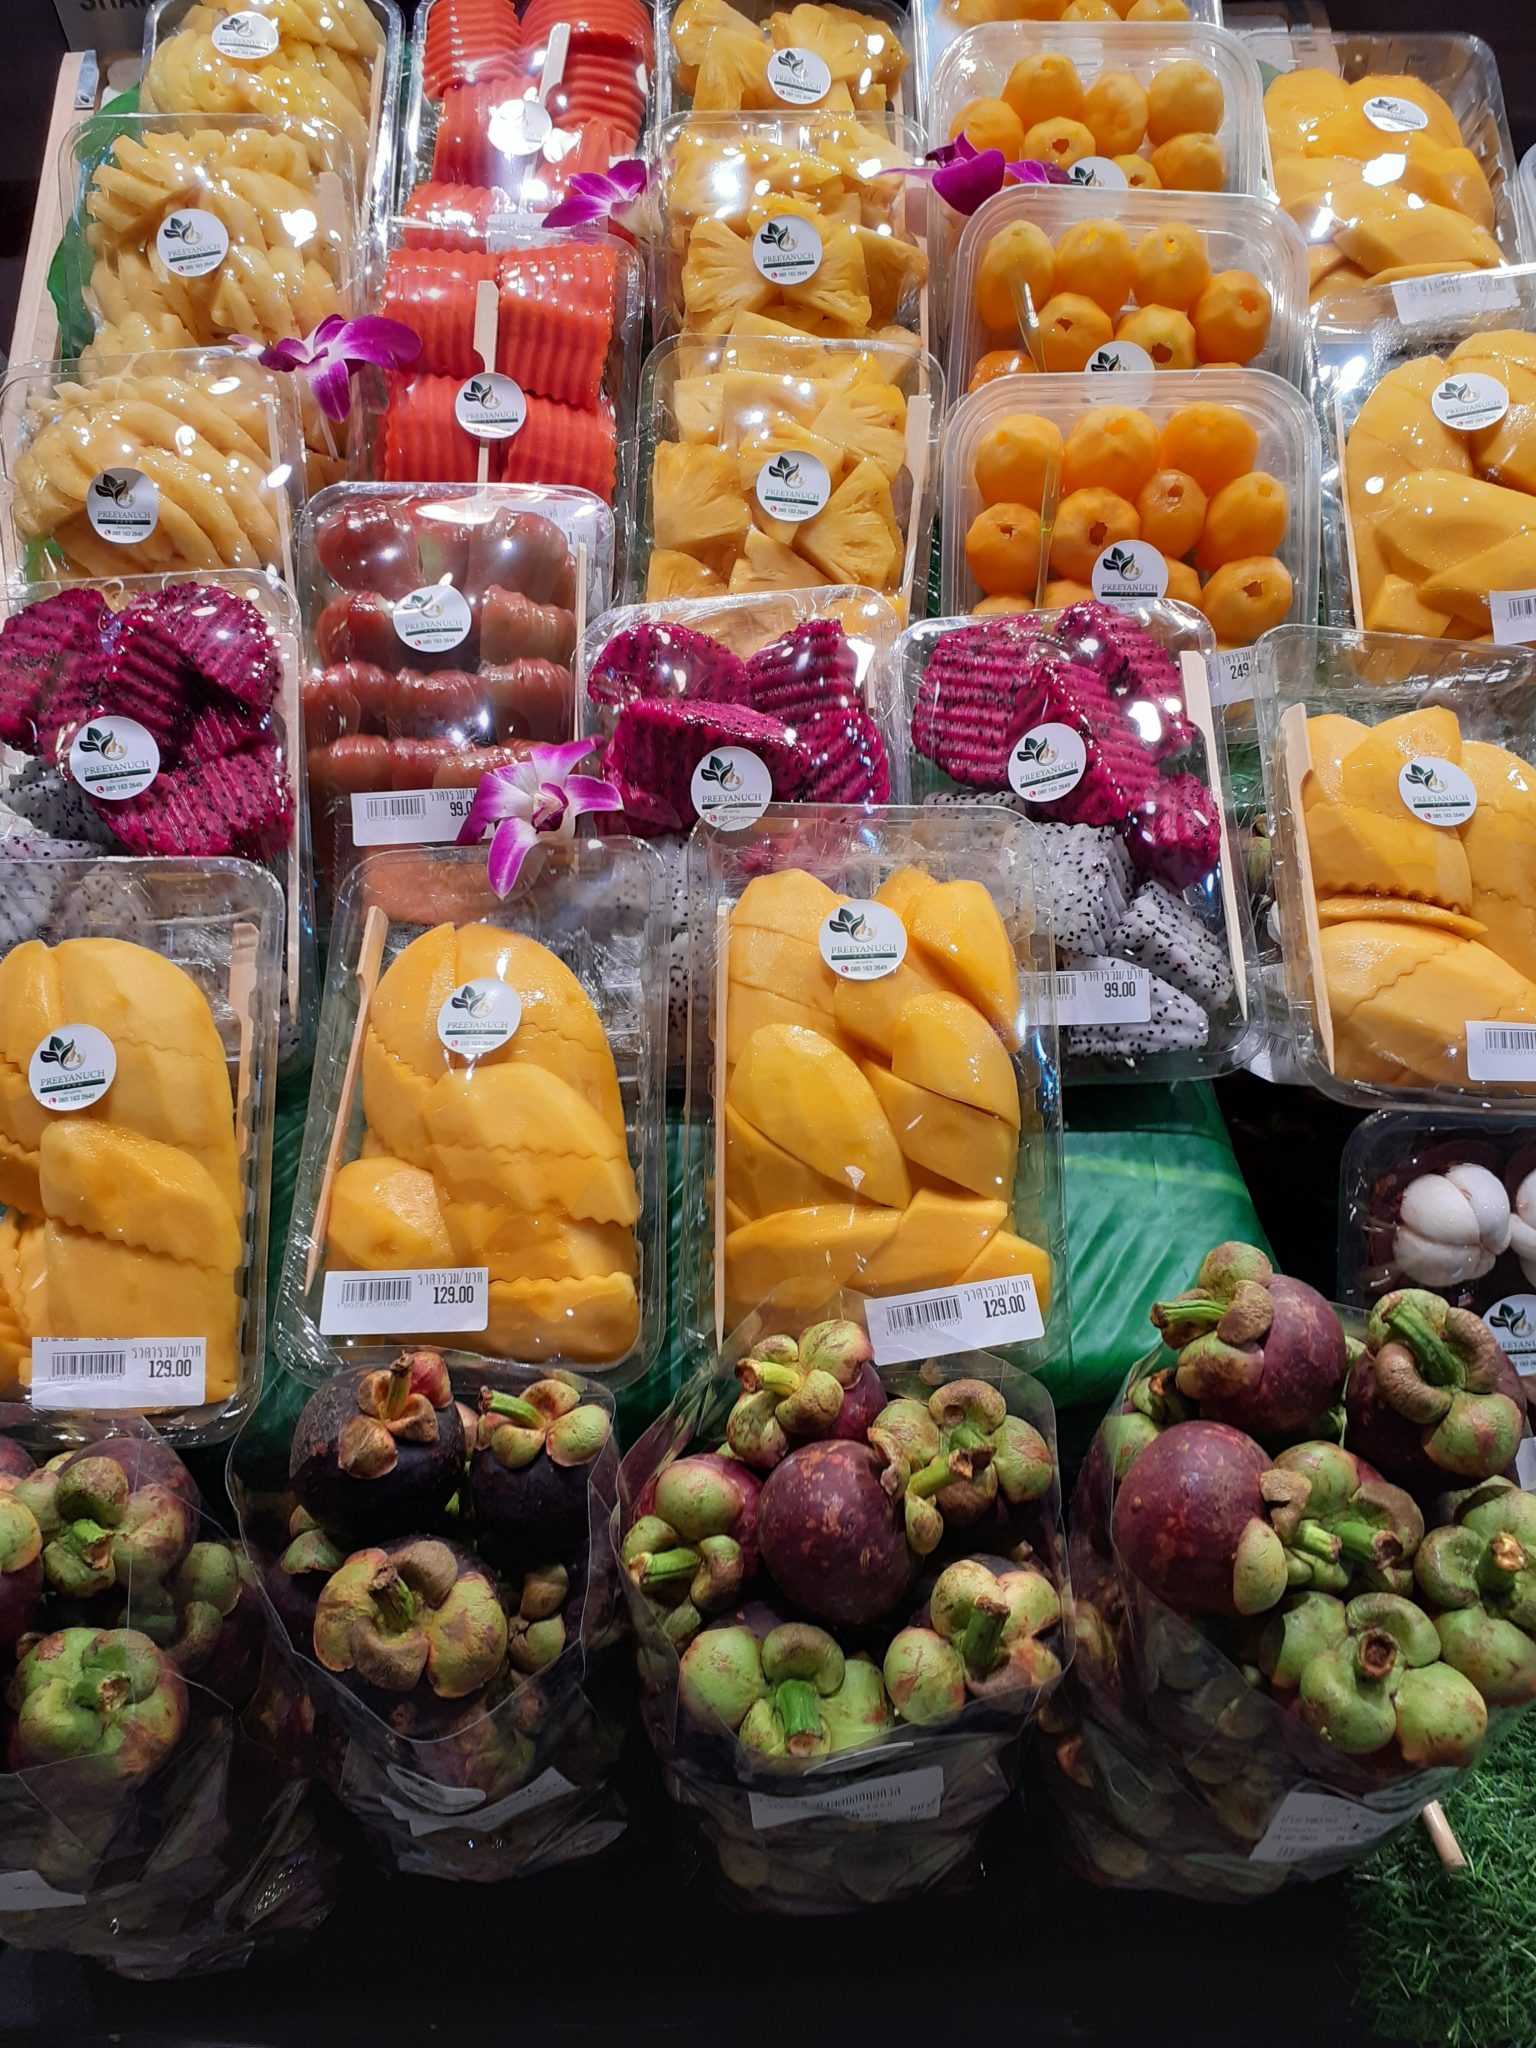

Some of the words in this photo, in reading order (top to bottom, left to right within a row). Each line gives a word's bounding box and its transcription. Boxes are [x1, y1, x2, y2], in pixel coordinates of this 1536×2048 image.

[168, 244, 221, 257] PREEYANUCH
[763, 252, 814, 263] PREEYANUCH
[466, 411, 518, 419] PREEYANUCH
[1445, 400, 1501, 416] PREEYANUCH
[766, 487, 820, 500] PREEYANUCH
[97, 511, 151, 519] PREEYANUCH
[405, 620, 463, 631] PREEYANUCH
[84, 760, 150, 775] PREEYANUCH
[1020, 760, 1078, 782] PREEYANUCH
[1058, 782, 1071, 790] 2649
[702, 793, 762, 803] PREEYANUCH
[1412, 794, 1469, 803] PREEYANUCH
[450, 801, 473, 817] 99.0
[831, 944, 897, 954] PREEYANUCH
[1104, 981, 1136, 998] 99.00
[447, 1020, 509, 1029] PREEYANUCH
[40, 1069, 105, 1087] PREEYANUCH
[417, 1270, 483, 1286] ราคารวม/บาท
[433, 1285, 474, 1305] 129.00
[963, 1279, 1032, 1302] ราคารวม/บาท
[983, 1294, 1026, 1318] 129.00
[132, 1344, 202, 1359] ราคารวม/บาท
[148, 1359, 192, 1378] 129.00
